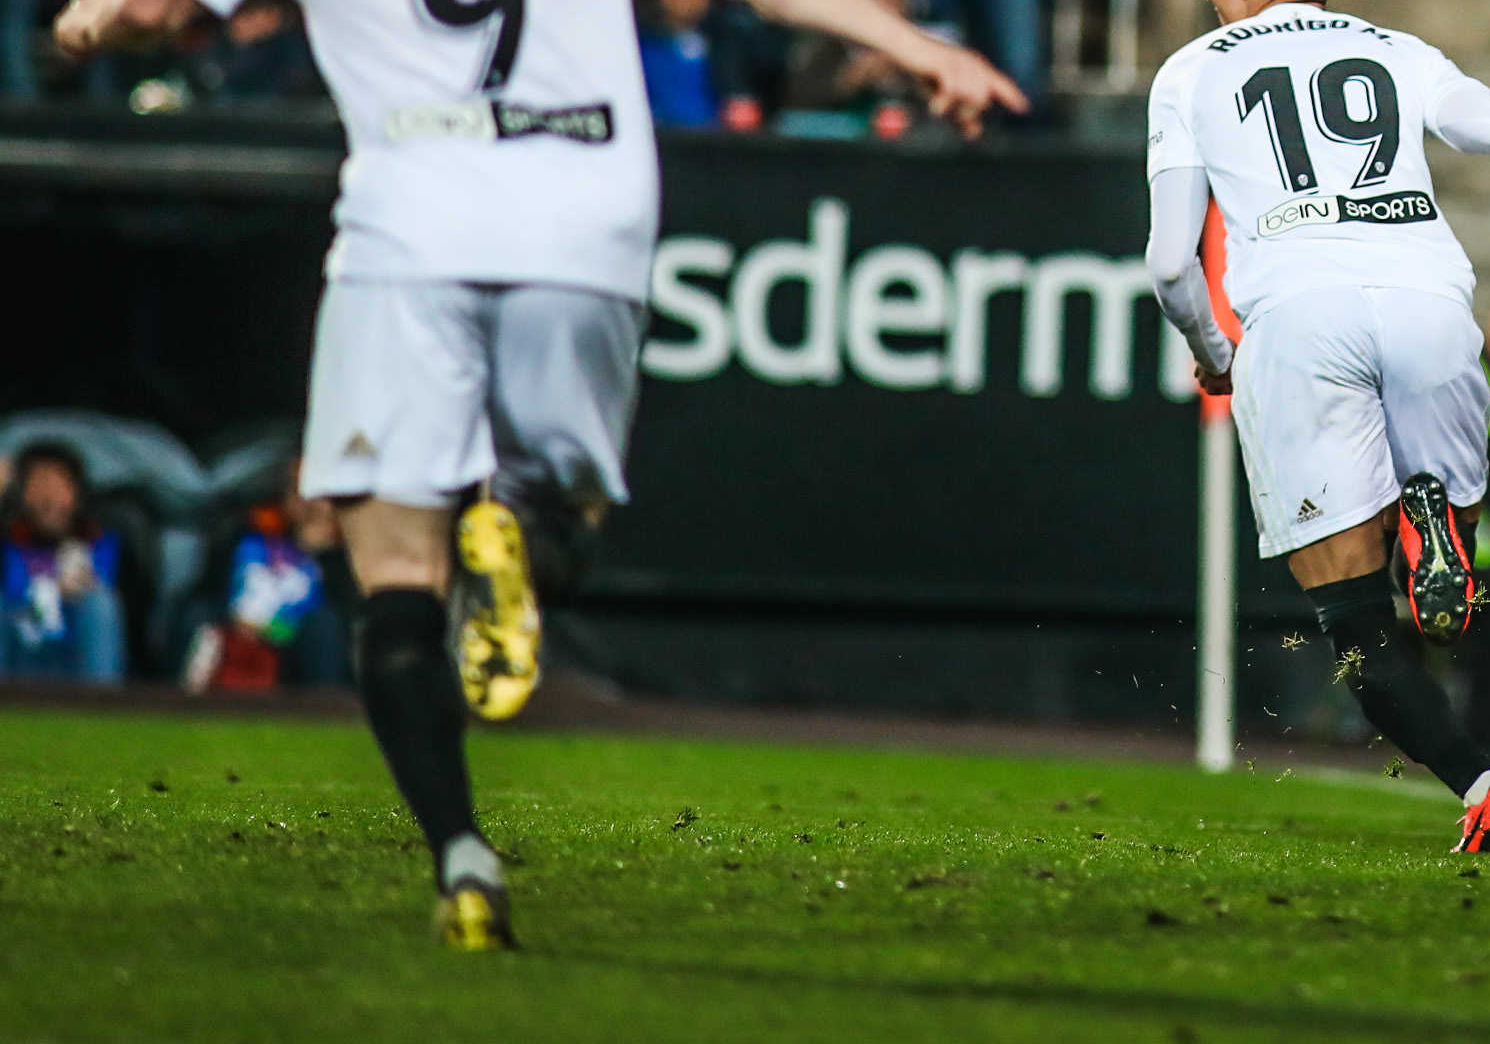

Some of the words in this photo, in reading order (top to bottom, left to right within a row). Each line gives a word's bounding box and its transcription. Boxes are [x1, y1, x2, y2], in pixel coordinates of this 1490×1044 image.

[1207, 18, 1350, 53] RODRIGO
[1235, 58, 1400, 195] 19
[1266, 203, 1329, 230] beIN
[1345, 196, 1431, 220] SPORTS
